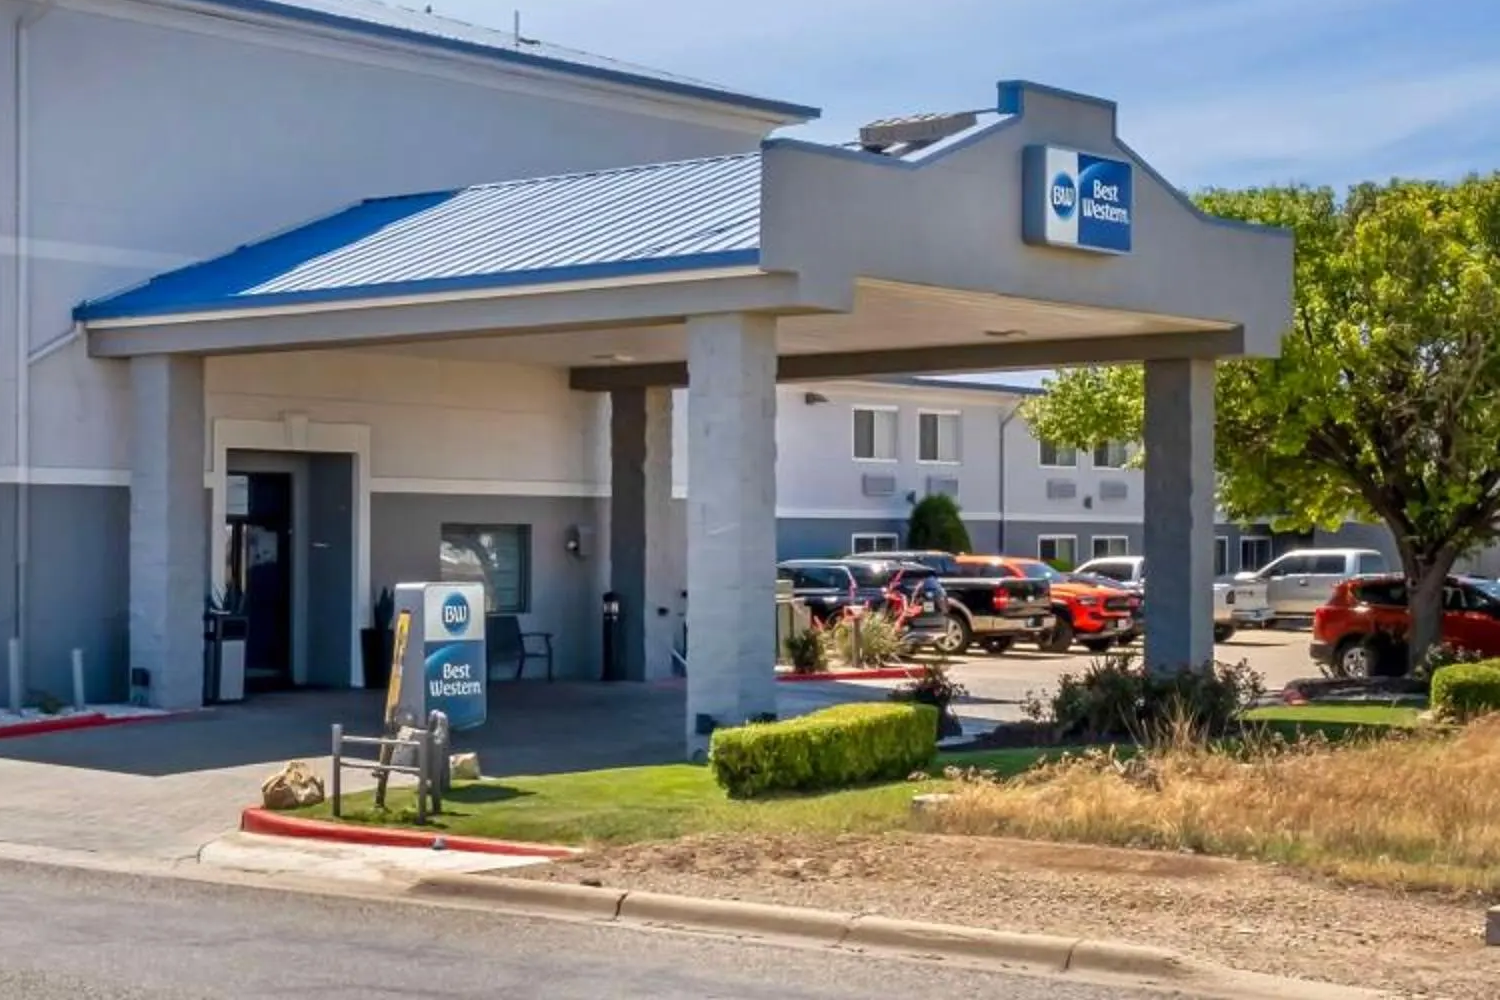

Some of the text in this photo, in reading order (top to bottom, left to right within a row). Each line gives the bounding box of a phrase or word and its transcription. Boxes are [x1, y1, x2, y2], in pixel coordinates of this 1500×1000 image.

[1093, 179, 1119, 202] Best
[1082, 197, 1128, 224] Western
[444, 605, 467, 623] BW
[443, 663, 471, 679] Best
[429, 680, 481, 697] Western
